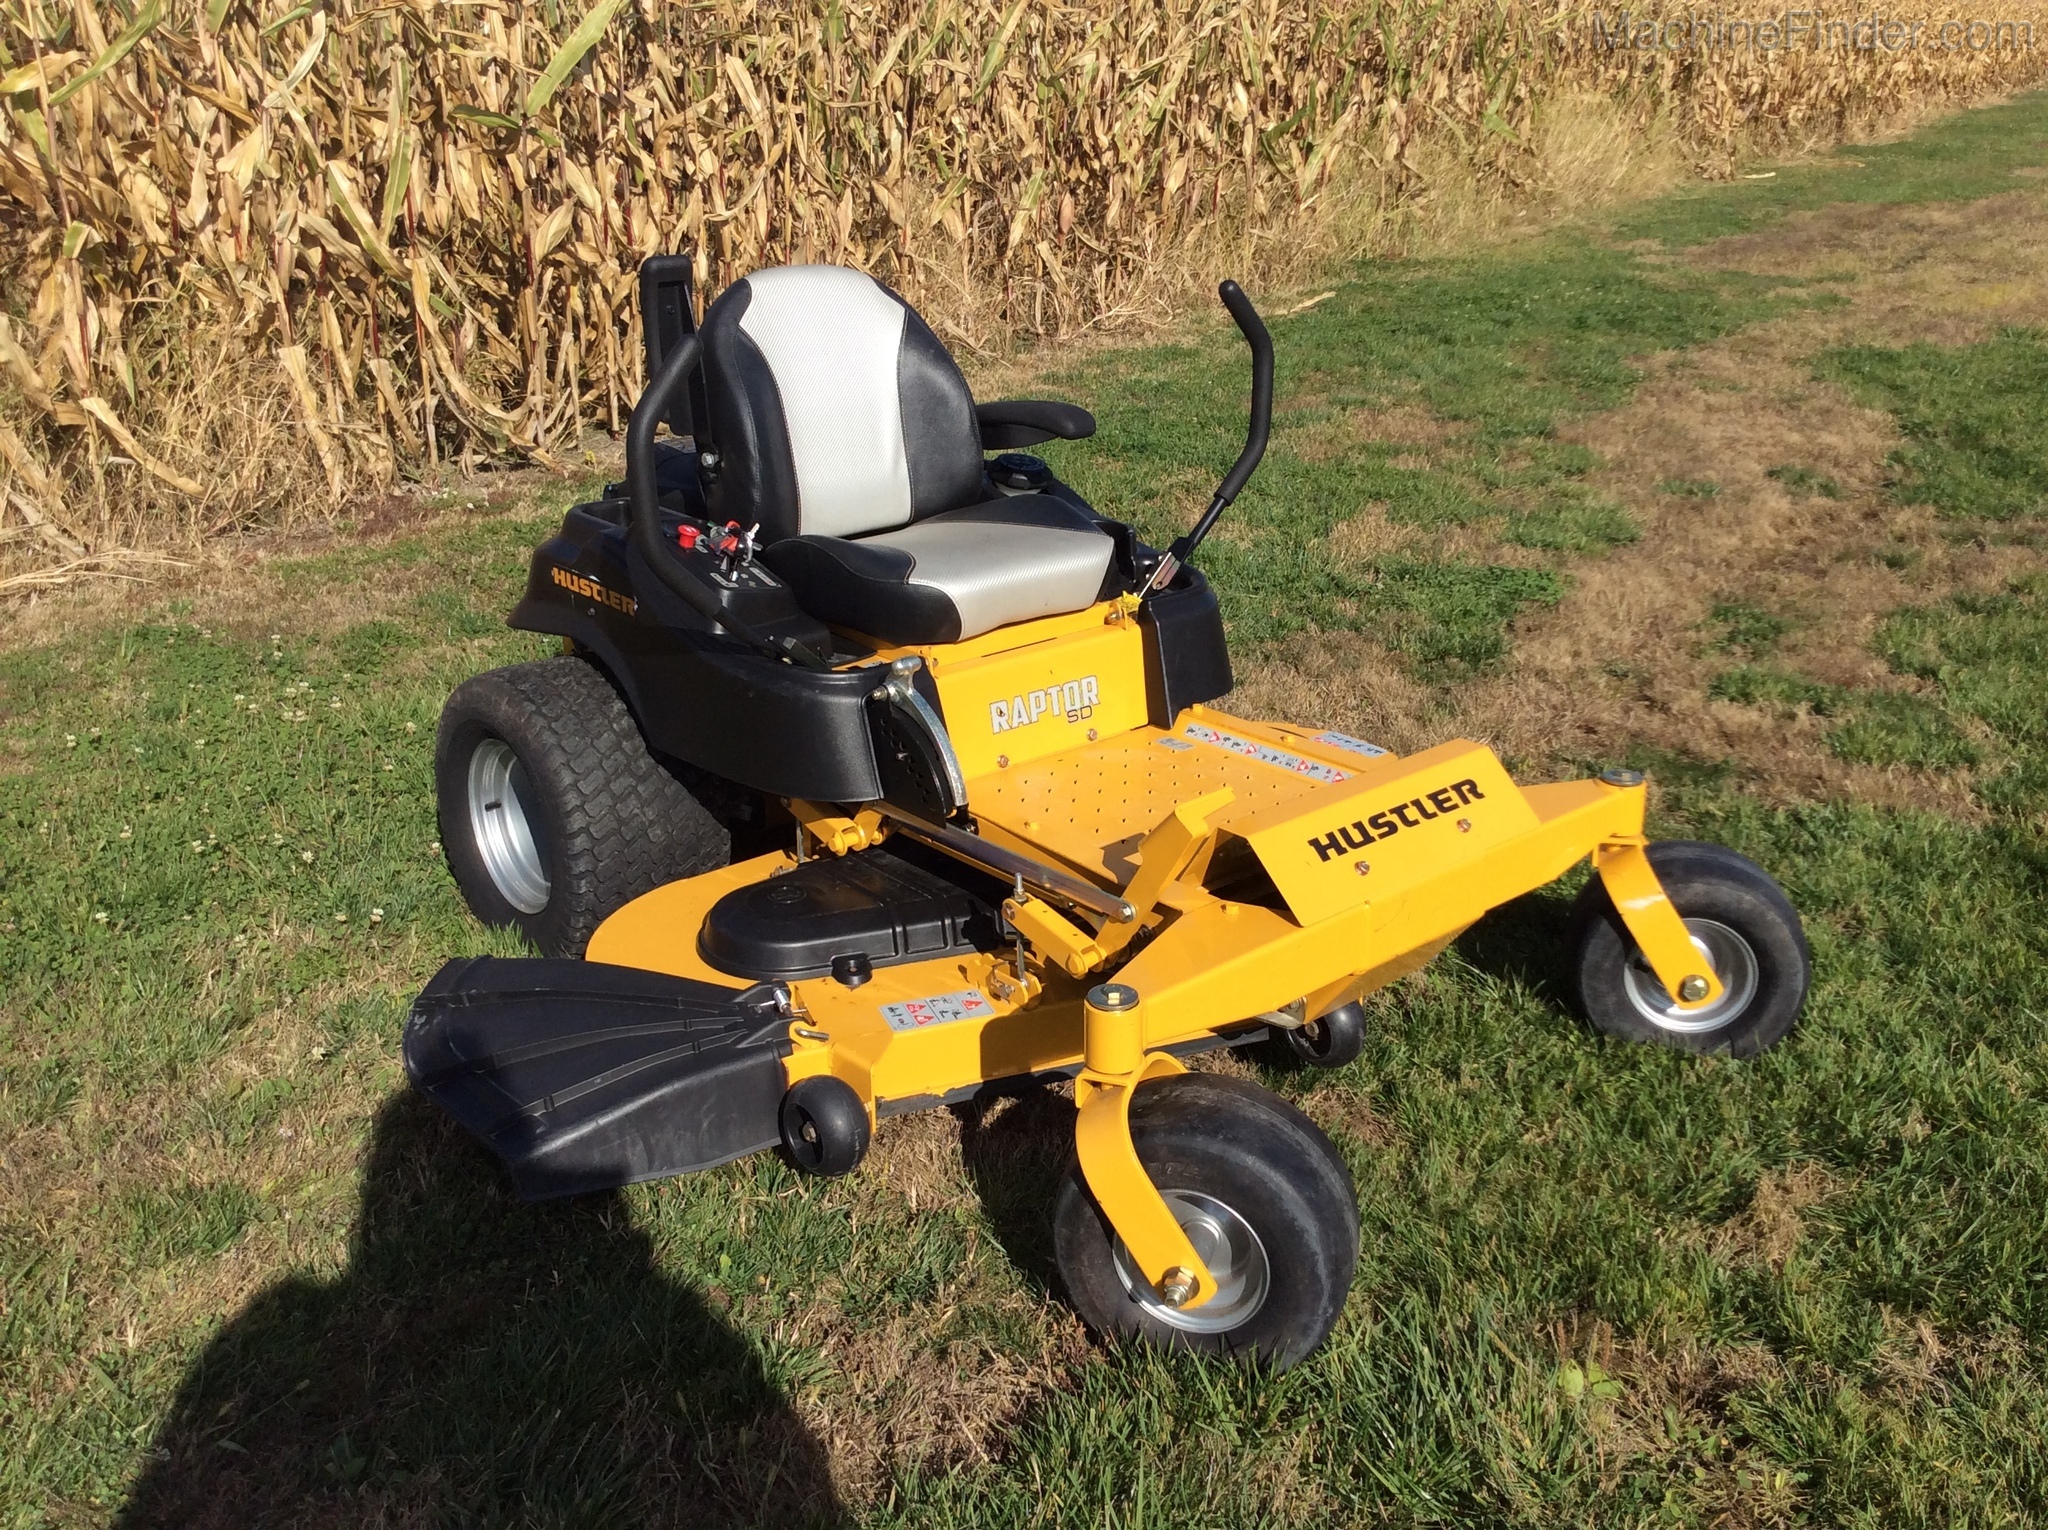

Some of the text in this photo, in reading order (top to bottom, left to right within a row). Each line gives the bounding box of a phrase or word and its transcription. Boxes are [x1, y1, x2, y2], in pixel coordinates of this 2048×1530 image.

[552, 566, 636, 616] HUSTLER
[989, 675, 1100, 735] RAPTOR
[1067, 705, 1093, 723] SD
[1307, 778, 1486, 863] HUSTLER
